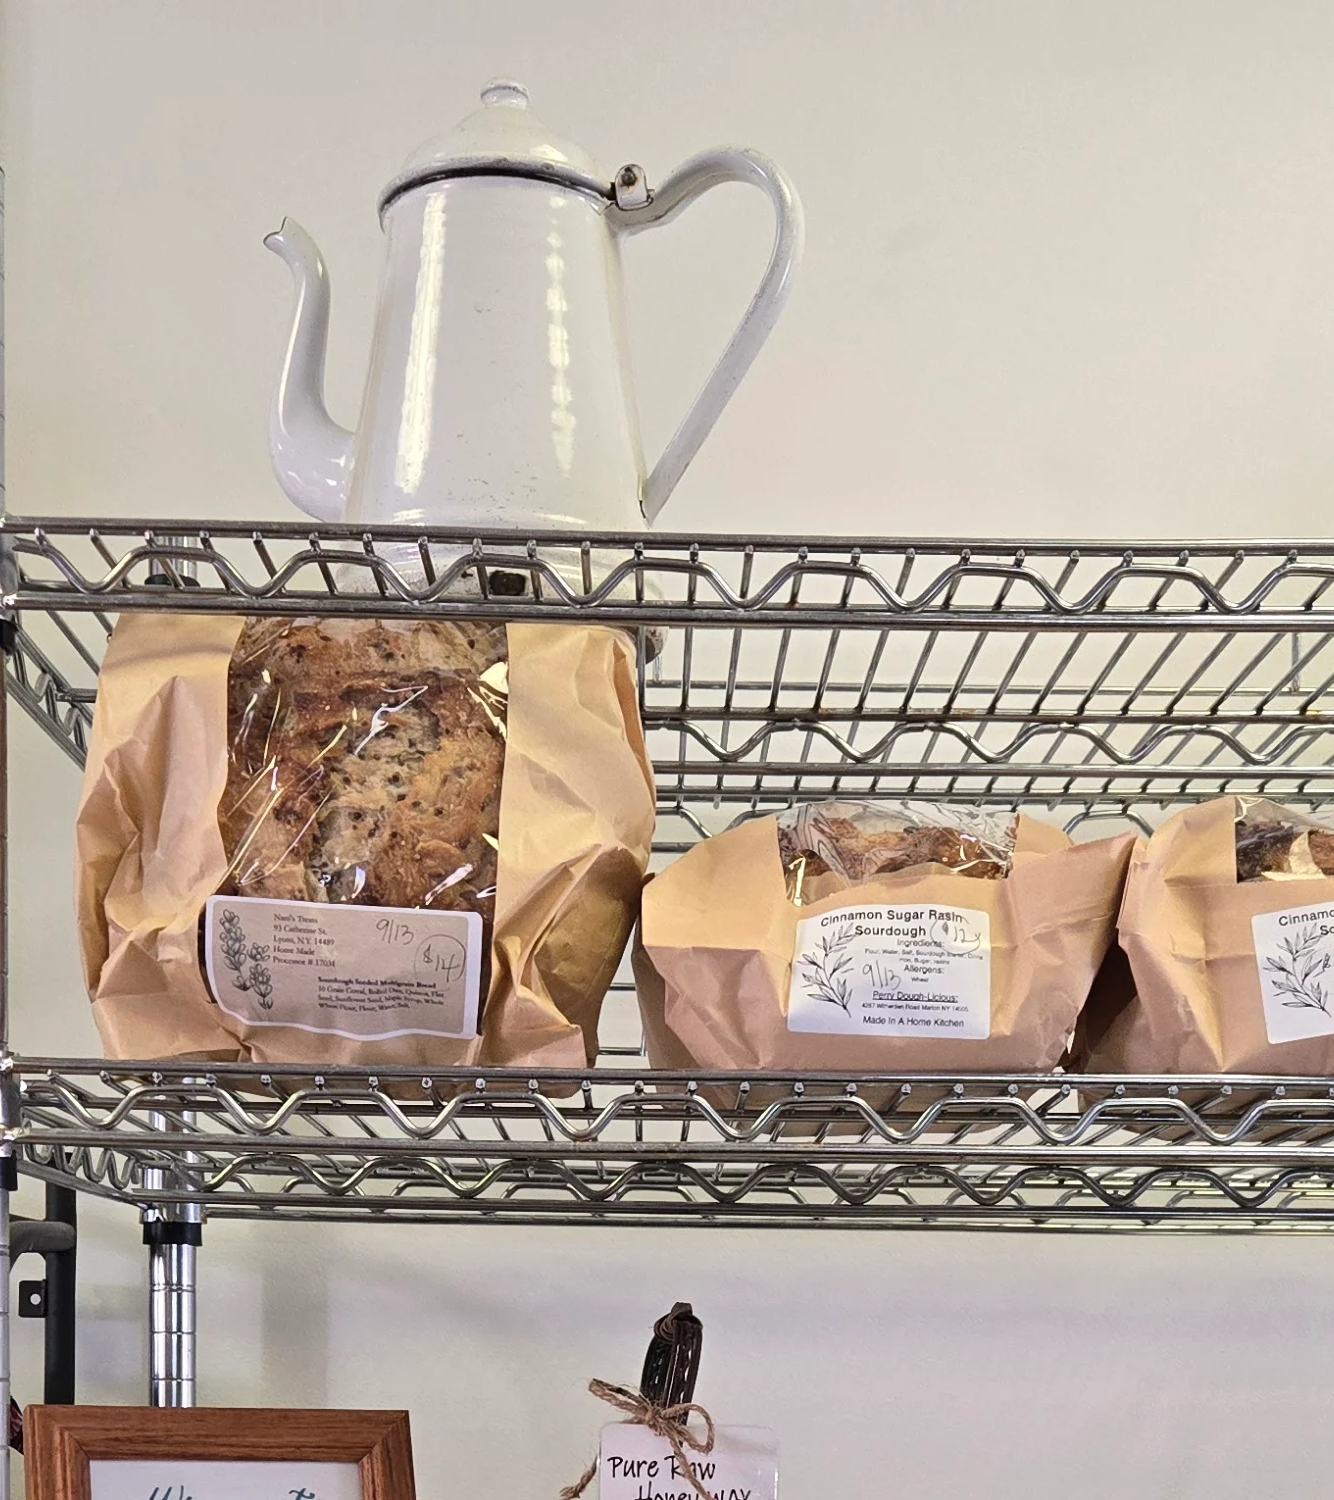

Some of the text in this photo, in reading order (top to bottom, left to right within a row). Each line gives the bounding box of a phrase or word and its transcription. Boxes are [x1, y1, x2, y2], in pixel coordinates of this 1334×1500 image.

[820, 910, 963, 927] Cinnamon Sugar Rasin
[855, 925, 927, 938] Sourdough
[862, 1016, 886, 1026] Made
[897, 1017, 905, 1026] A
[907, 1018, 931, 1027] Home
[933, 1018, 965, 1028] Kitchen
[607, 1456, 659, 1478] Pure
